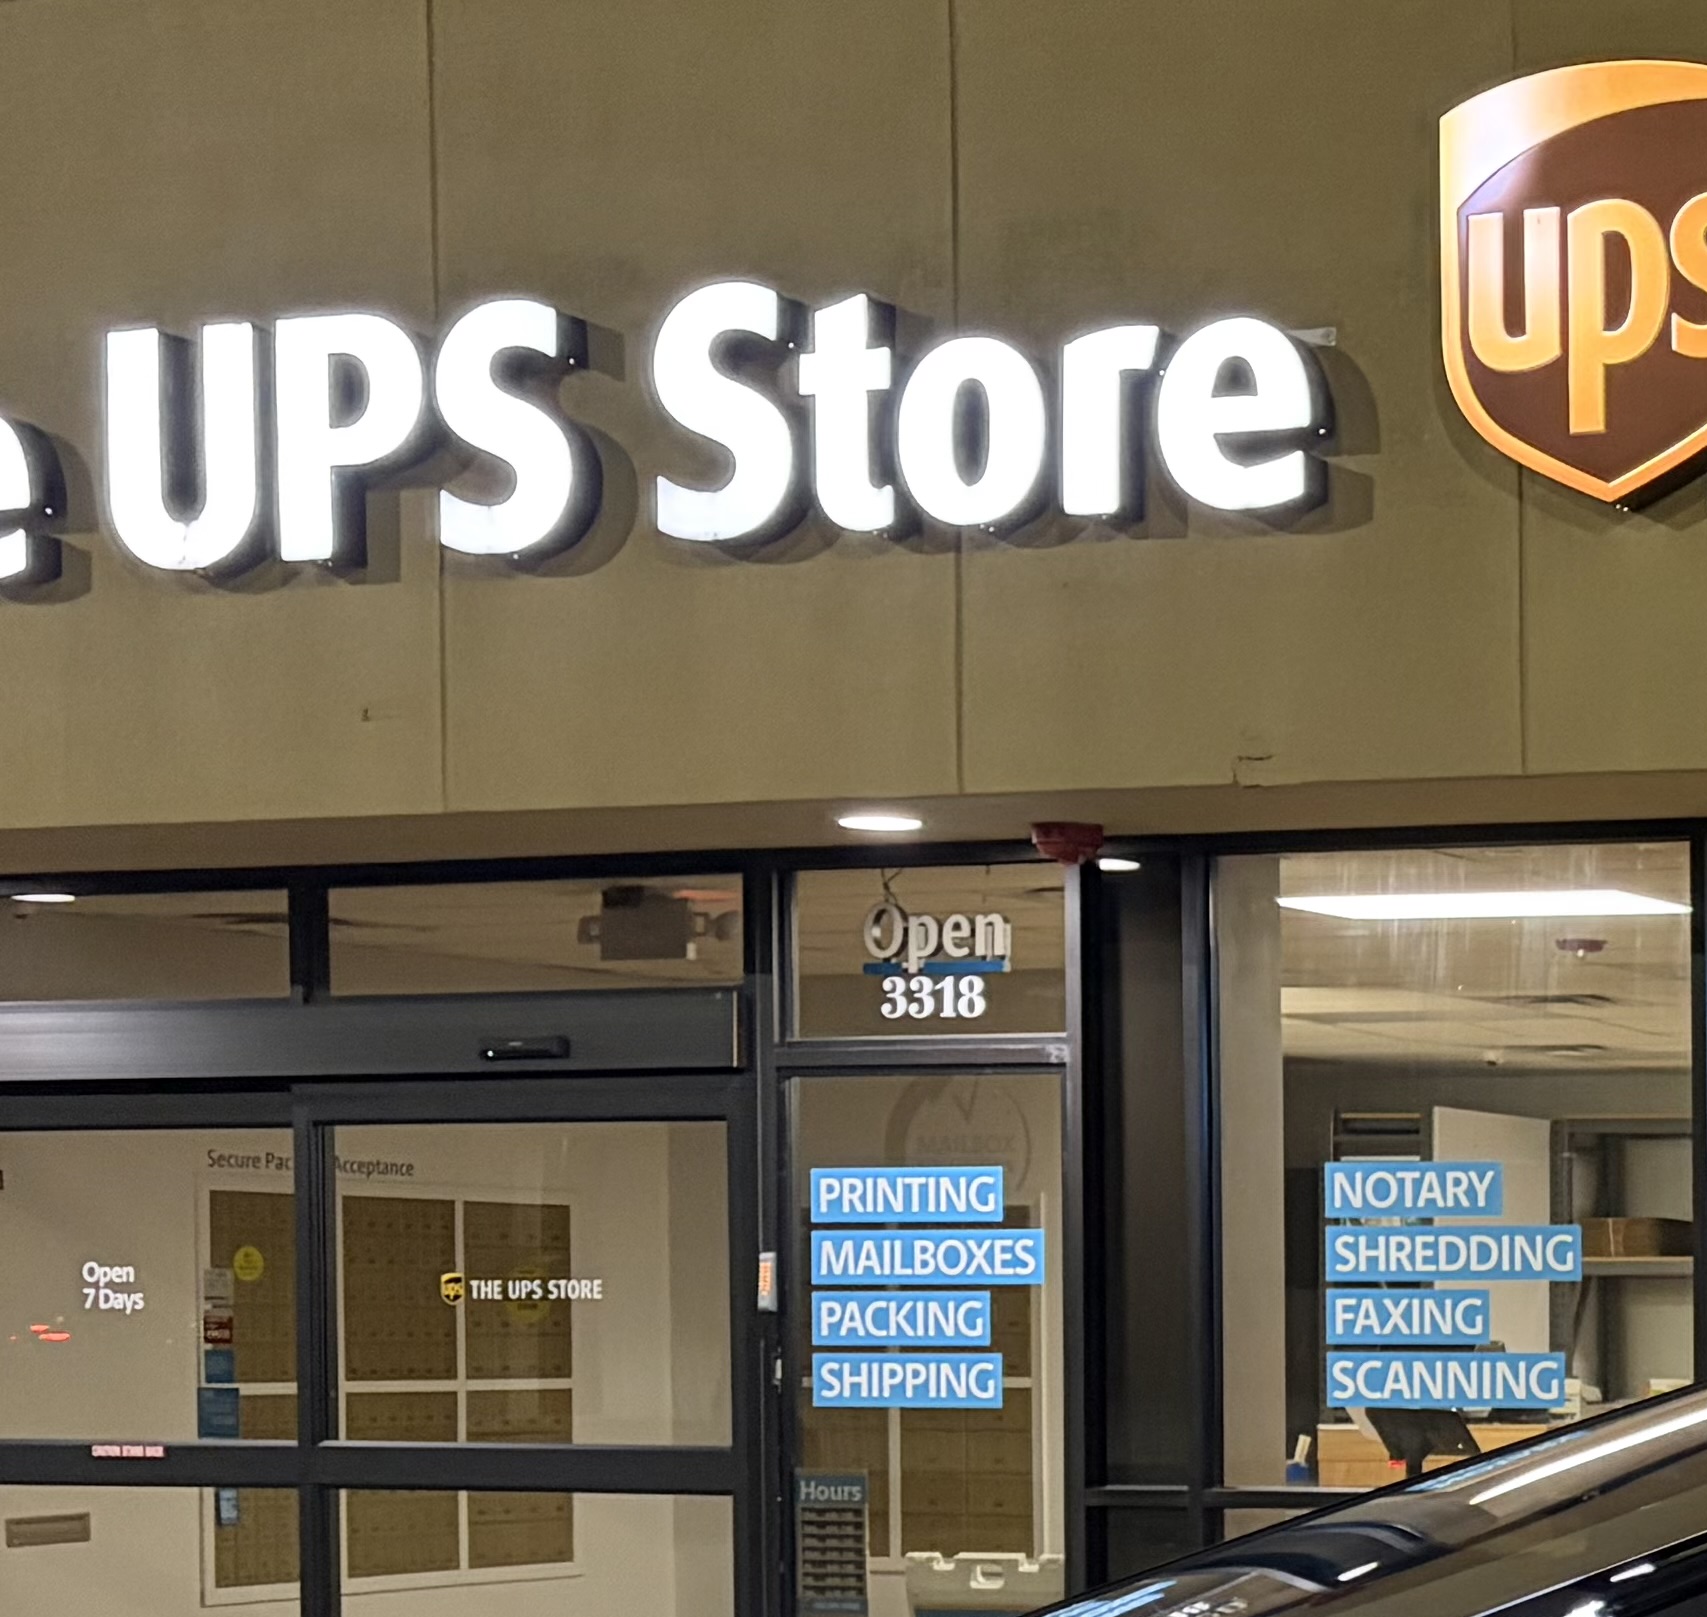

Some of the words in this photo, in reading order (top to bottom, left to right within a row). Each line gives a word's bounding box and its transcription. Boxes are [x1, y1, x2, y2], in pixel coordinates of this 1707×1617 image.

[106, 298, 573, 571] UPS
[652, 281, 1312, 542] Store
[863, 901, 1007, 974] Open
[880, 975, 987, 1019] 3318
[207, 1149, 262, 1170] Secure
[819, 1176, 996, 1213] PRINTING
[1333, 1171, 1495, 1209] NOTARY
[819, 1239, 1036, 1276] MAILBOXES
[1334, 1234, 1575, 1273] SHREDDING
[82, 1261, 135, 1286] Open
[470, 1279, 503, 1300] THE
[507, 1278, 543, 1300] UPS
[547, 1278, 603, 1300] STORE
[82, 1289, 95, 1310] 7
[99, 1288, 145, 1315] Days
[820, 1301, 983, 1337] PACKING
[1334, 1298, 1483, 1335] FAXING
[820, 1362, 995, 1399] SHIPPING
[1332, 1360, 1560, 1400] SCANNING
[800, 1480, 863, 1501] Hours
